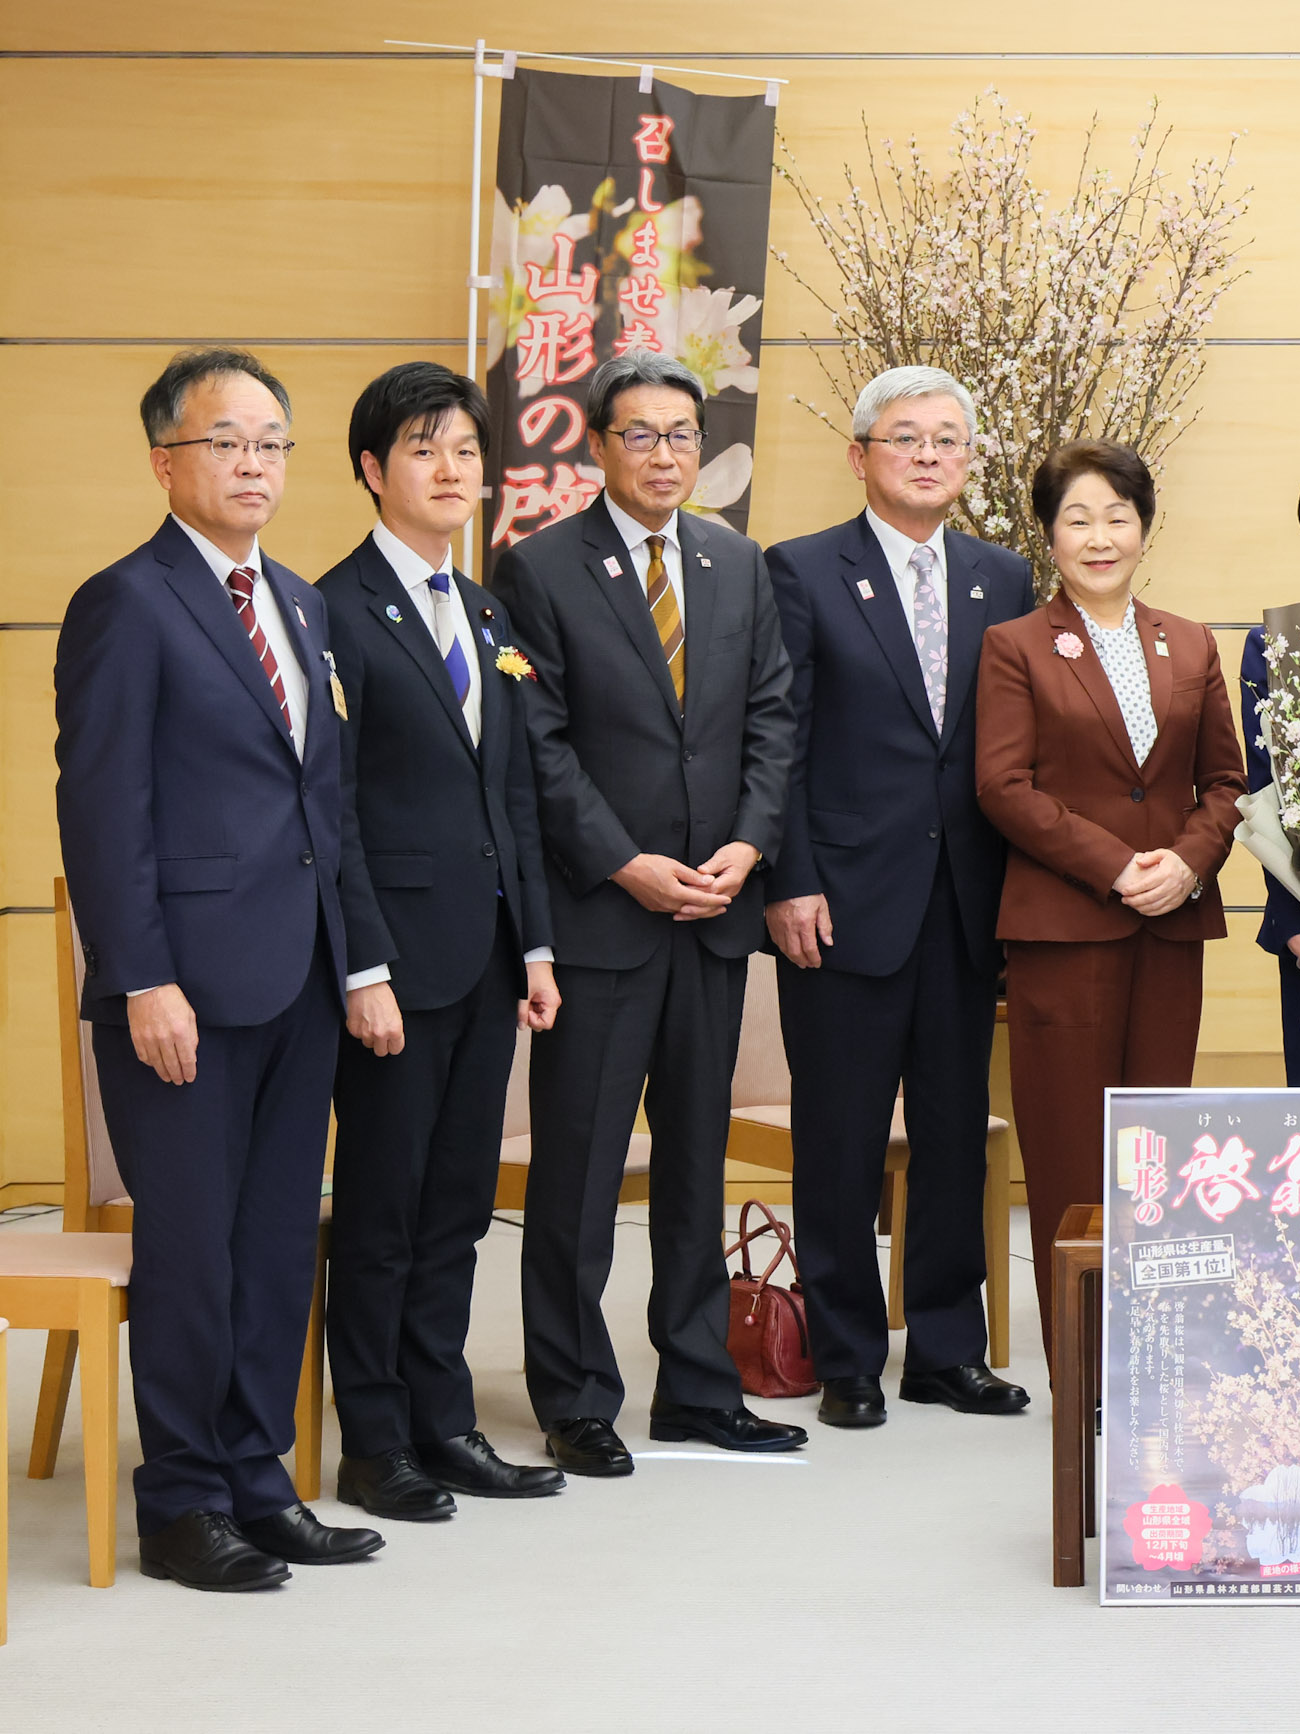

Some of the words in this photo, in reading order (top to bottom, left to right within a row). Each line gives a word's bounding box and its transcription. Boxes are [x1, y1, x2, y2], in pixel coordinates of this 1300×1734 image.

[1198, 1112, 1242, 1127] けい
[1132, 1130, 1167, 1226] 山形の
[1138, 1239, 1225, 1259] 山形県は生産量
[1142, 1515, 1191, 1526] 山形県全域
[1146, 1540, 1189, 1551] 12月下旬
